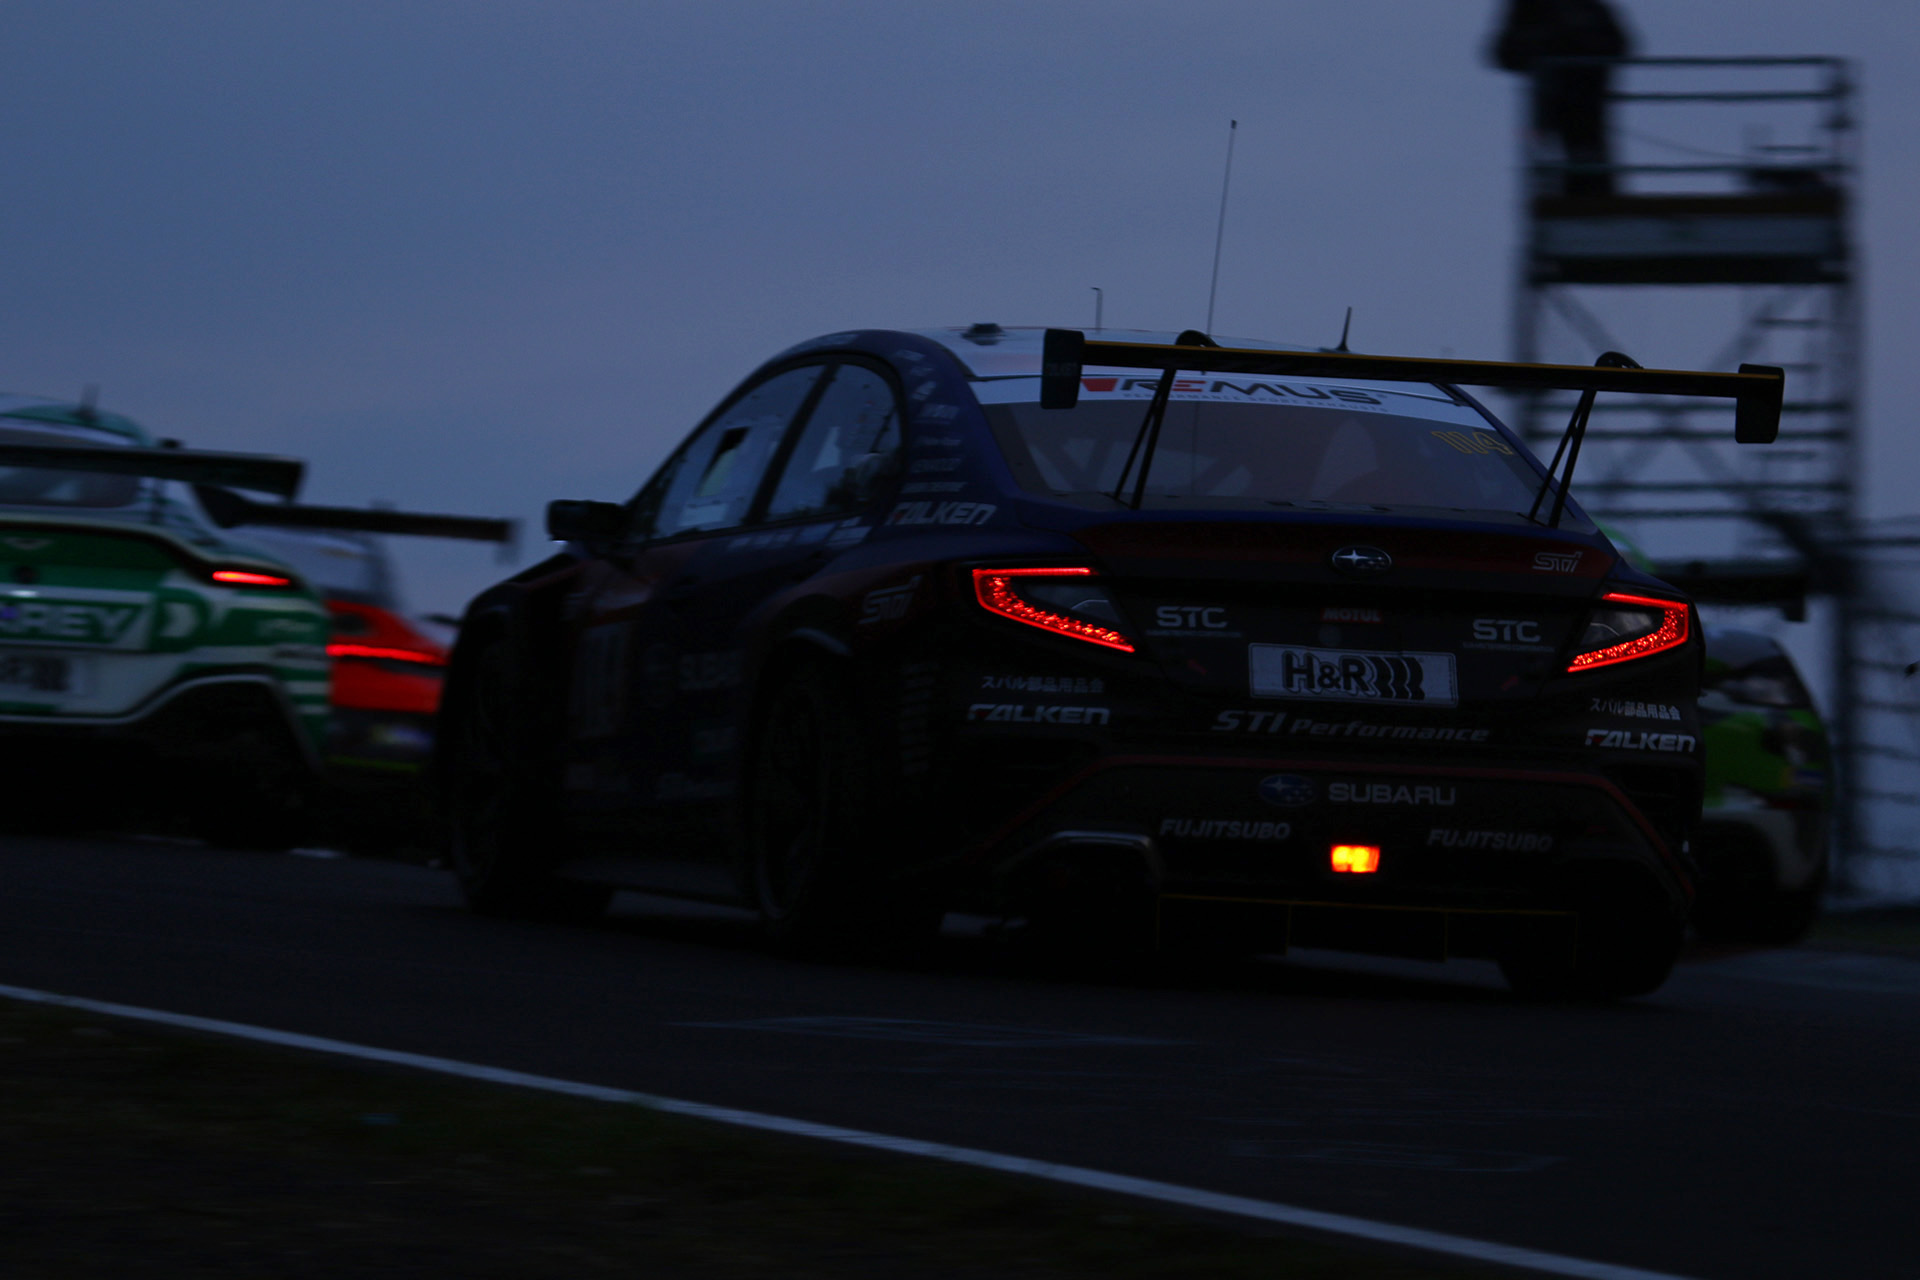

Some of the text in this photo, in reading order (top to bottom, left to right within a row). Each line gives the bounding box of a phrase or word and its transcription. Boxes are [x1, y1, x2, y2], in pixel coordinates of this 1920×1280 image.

[1121, 379, 1381, 404] REMUS
[884, 501, 998, 525] FALKEN
[1156, 605, 1228, 629] STC
[1322, 607, 1382, 622] MOTUL
[1472, 618, 1542, 642] STC
[1283, 651, 1377, 697] H&R
[966, 703, 1111, 725] FALKEN
[1210, 709, 1491, 742] STI Performance
[1584, 728, 1697, 753] FALKEN
[1328, 782, 1456, 806] SUBARU
[1159, 817, 1292, 841] FUJITSUBO
[1426, 828, 1554, 854] FUJITSUBO
